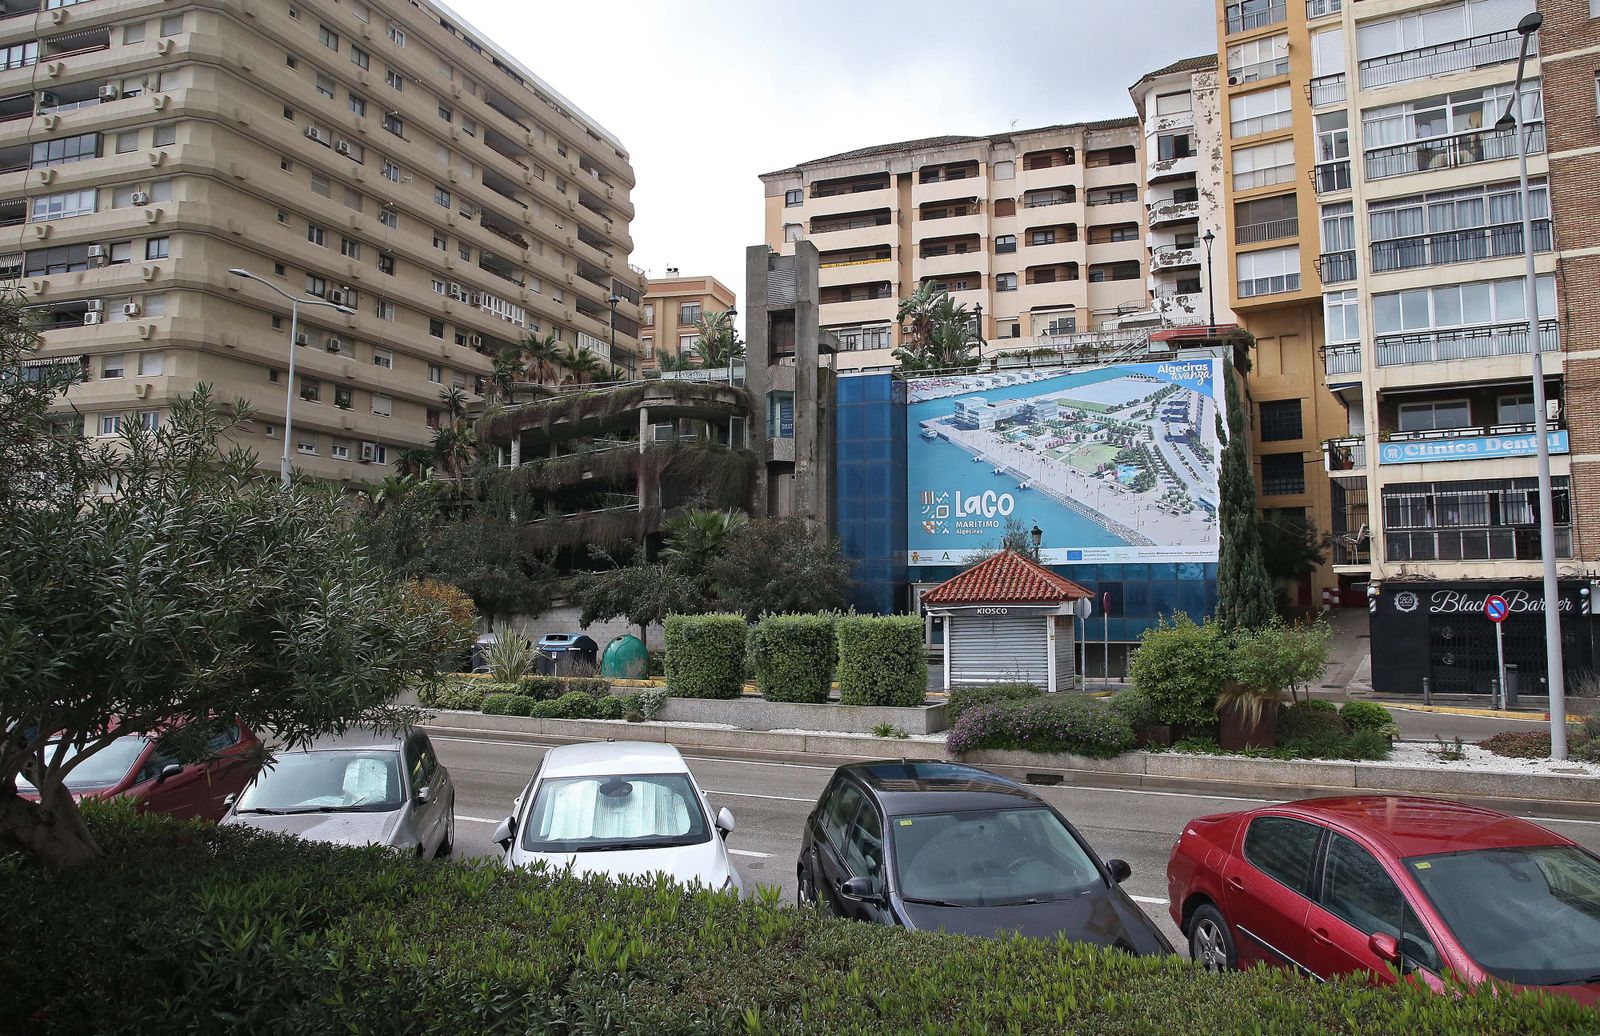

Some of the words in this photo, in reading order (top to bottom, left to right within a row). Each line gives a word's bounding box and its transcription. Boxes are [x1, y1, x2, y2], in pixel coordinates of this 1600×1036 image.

[1158, 363, 1208, 374] Algeciras
[1171, 370, 1213, 385] avanza
[1486, 434, 1560, 451] Dentl
[955, 519, 1000, 528] MARÍTIMO
[1500, 590, 1573, 613] Barer
